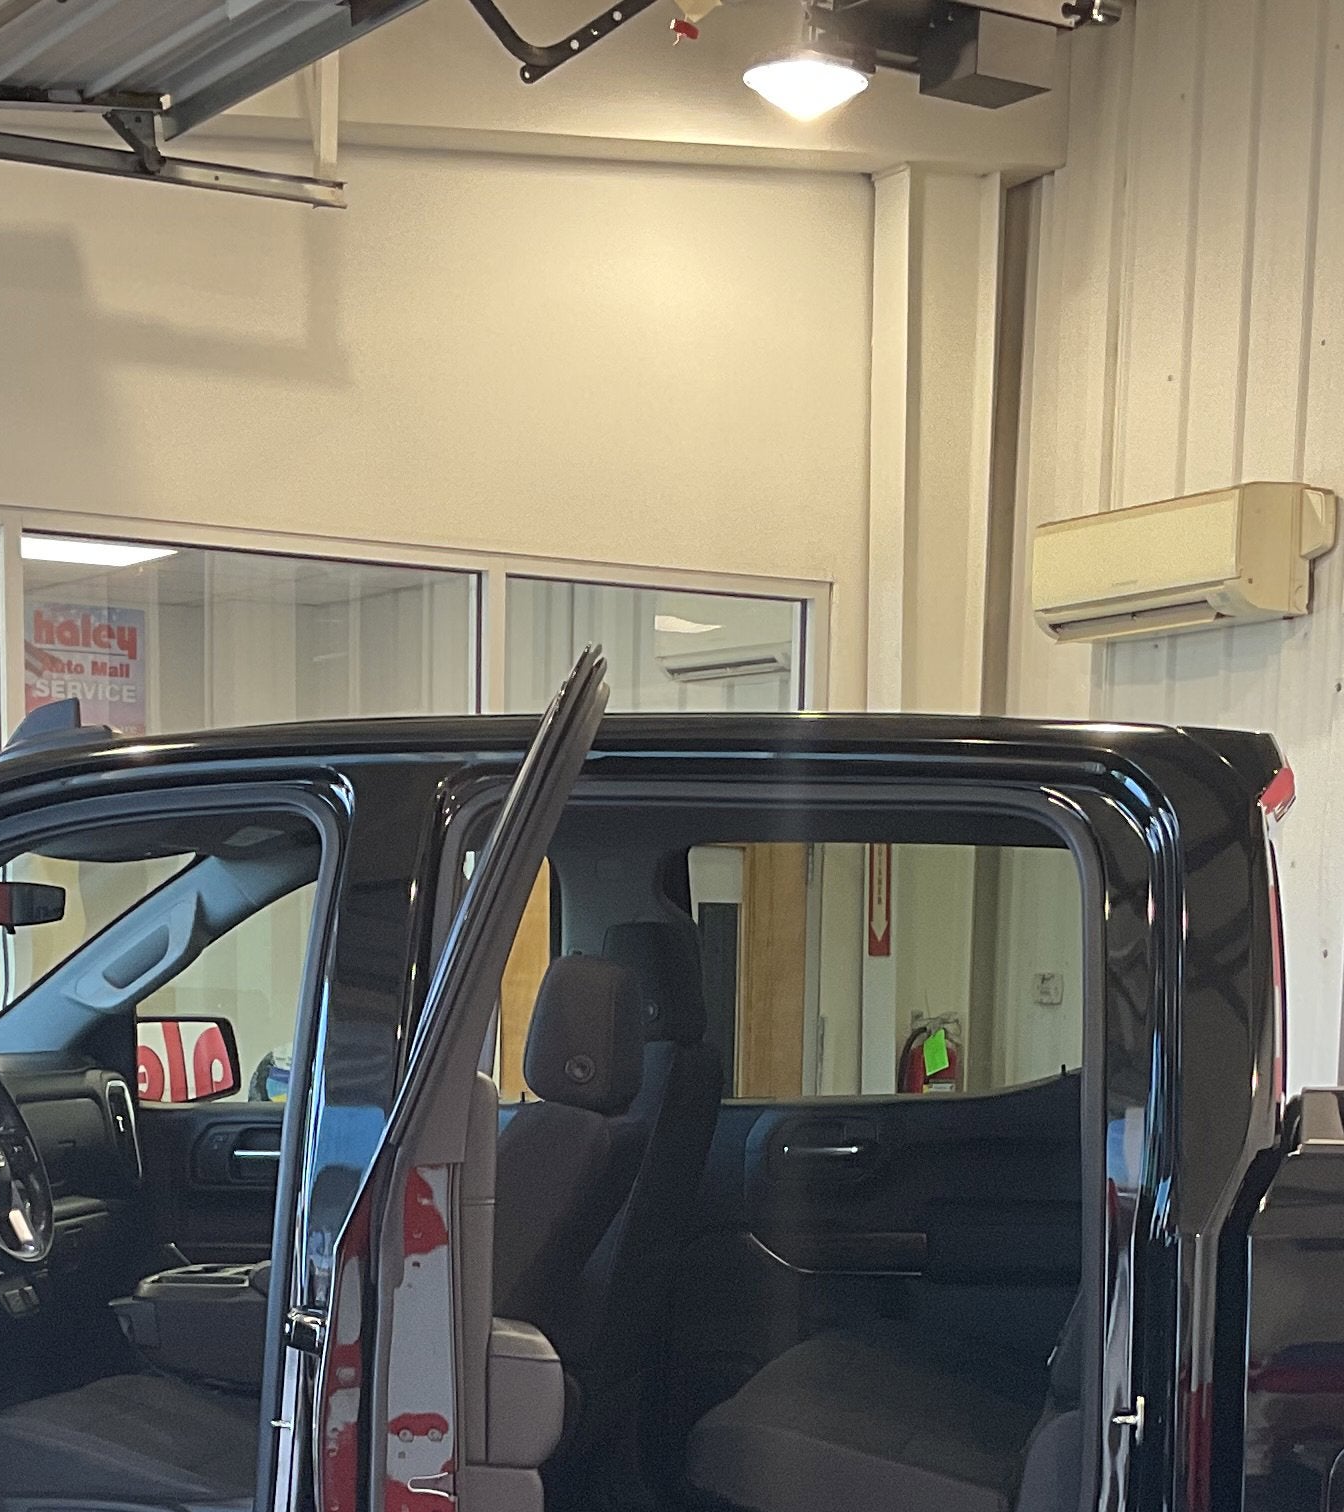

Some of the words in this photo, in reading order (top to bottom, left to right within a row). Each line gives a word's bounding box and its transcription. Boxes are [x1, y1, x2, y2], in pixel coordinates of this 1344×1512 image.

[33, 608, 138, 660] haley
[42, 657, 84, 675] Auto
[91, 660, 130, 678] Mall
[33, 678, 137, 703] SERVICE
